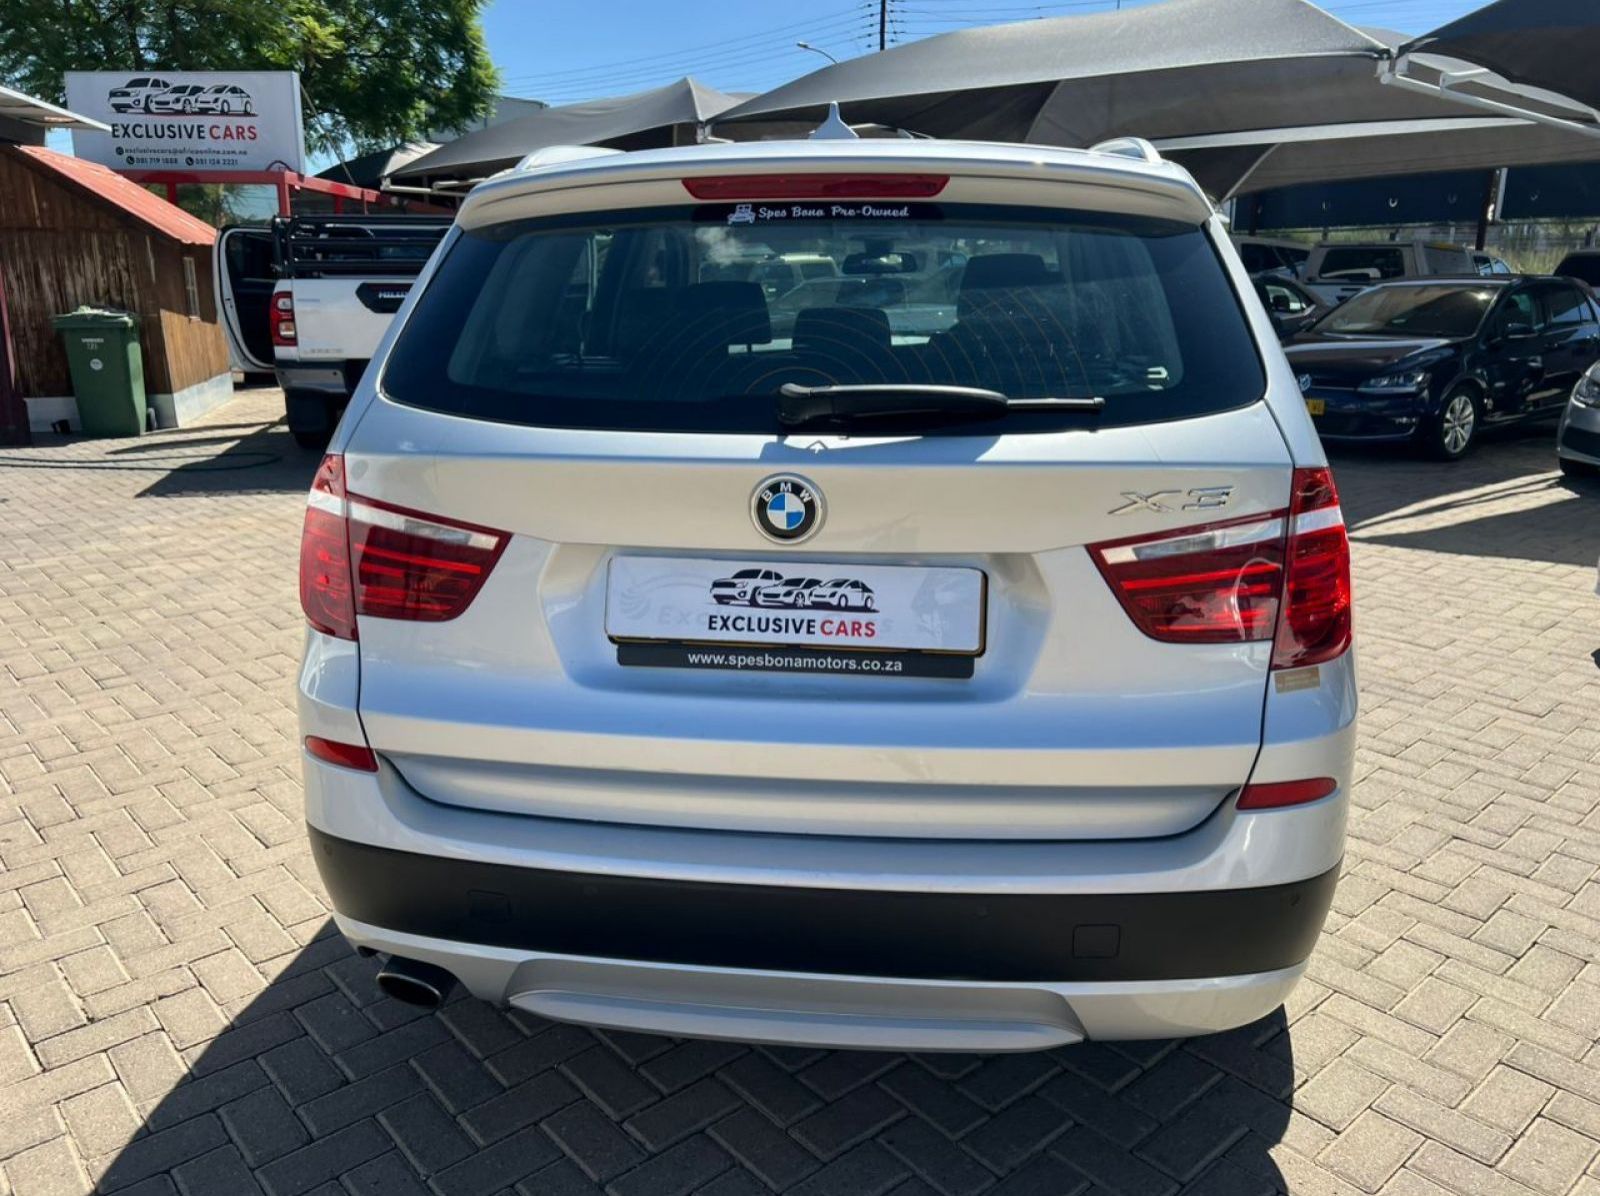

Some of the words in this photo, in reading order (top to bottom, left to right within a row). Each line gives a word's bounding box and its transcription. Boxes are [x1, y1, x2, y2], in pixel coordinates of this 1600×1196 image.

[111, 124, 206, 140] EXCLUSIVE
[209, 125, 257, 141] CARS
[758, 206, 787, 219] Spes
[792, 206, 825, 217] Bona
[831, 205, 909, 218] Pre-Owned
[761, 482, 812, 503] BMW
[1106, 485, 1235, 515] X3
[708, 615, 816, 635] EXCLUSIVE
[820, 619, 876, 638] CARS
[688, 651, 903, 673] www.spesbonamotors.co.za
